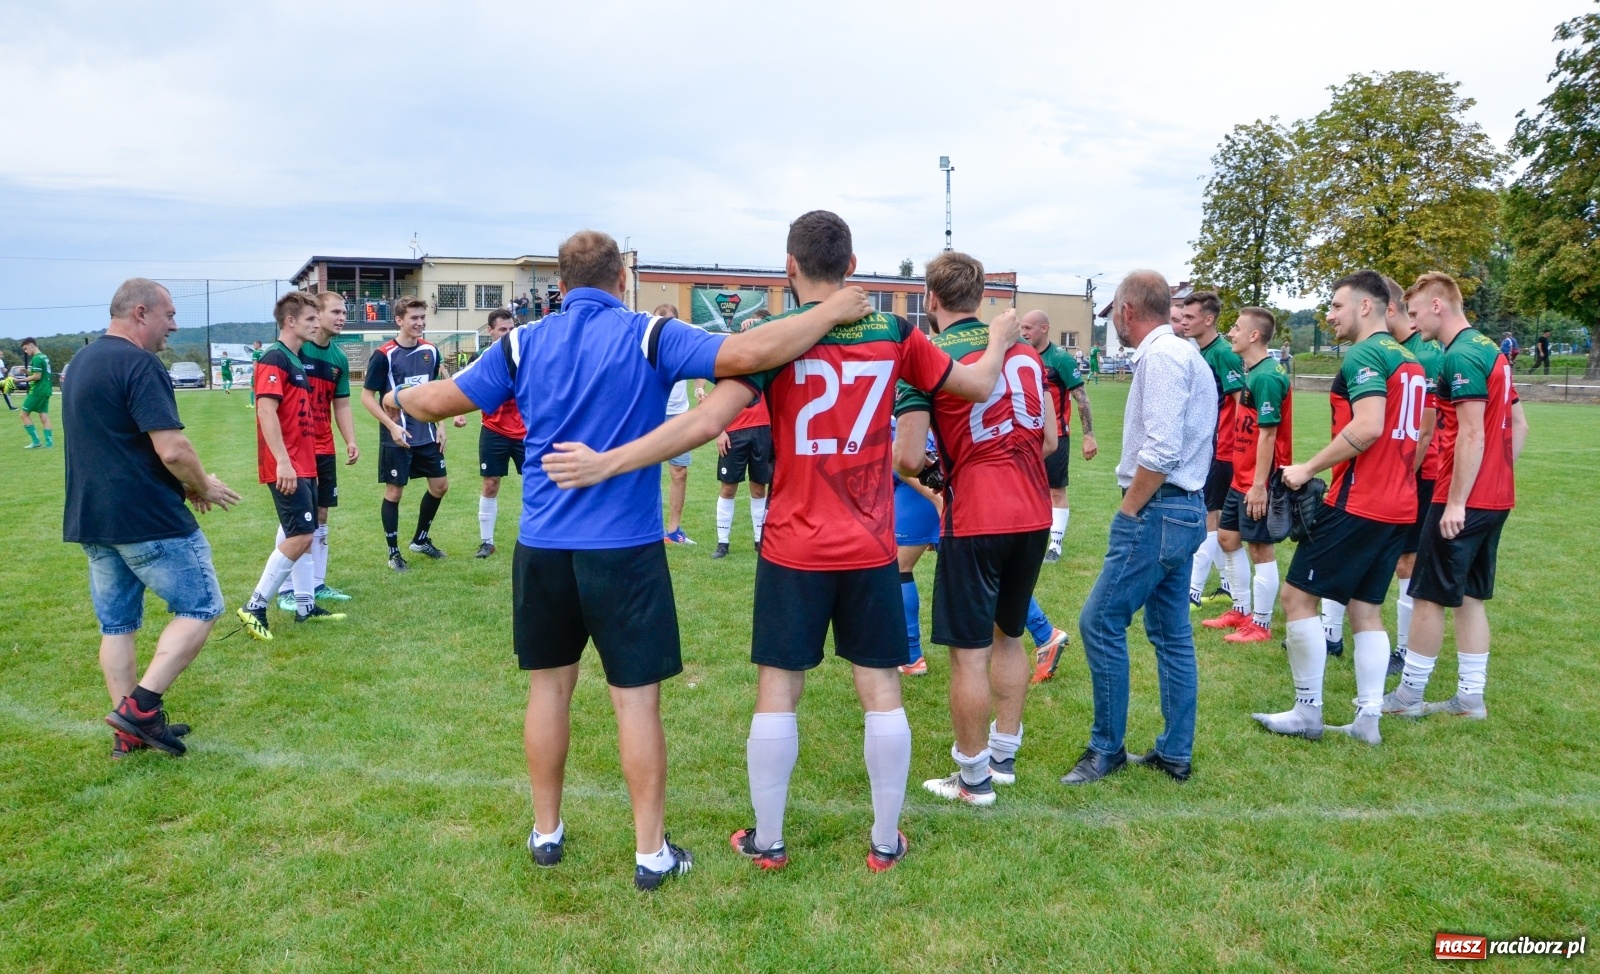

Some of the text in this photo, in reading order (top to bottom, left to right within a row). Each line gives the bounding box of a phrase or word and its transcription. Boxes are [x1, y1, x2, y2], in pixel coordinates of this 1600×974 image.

[794, 359, 895, 455] 27
[966, 354, 1046, 444] 20
[1391, 372, 1427, 441] 10
